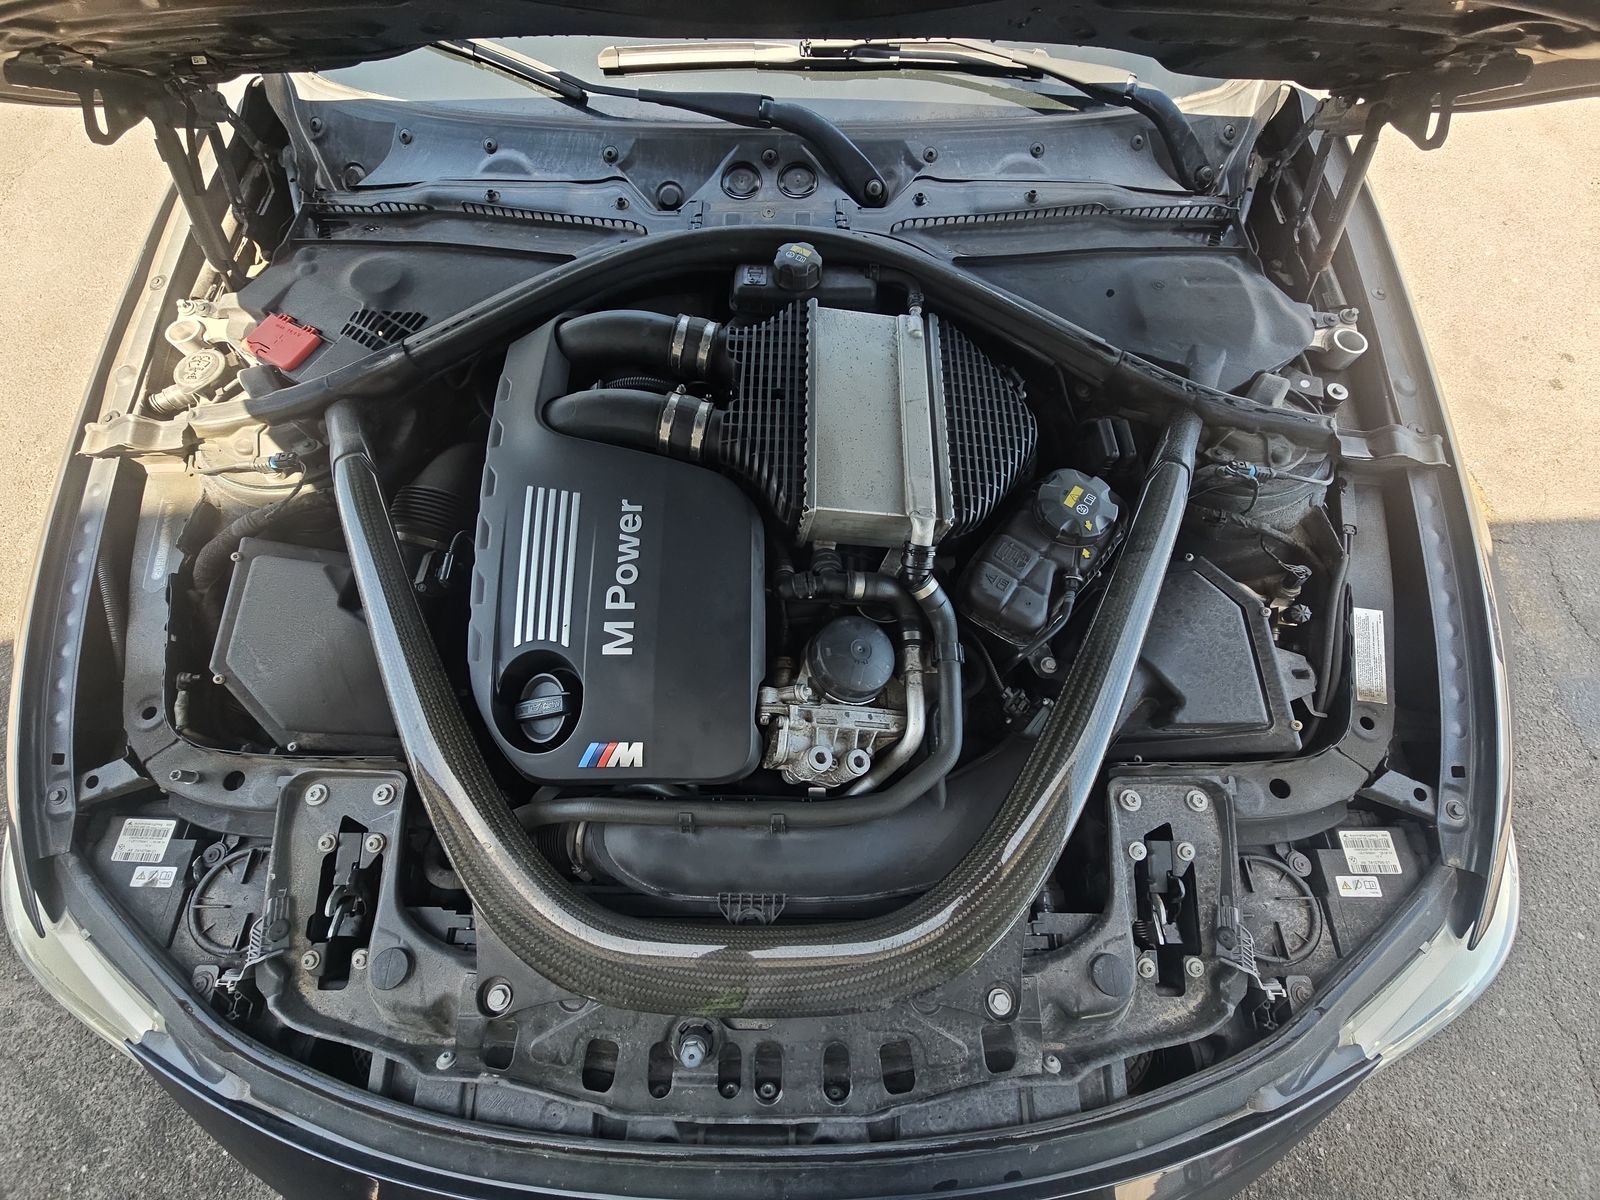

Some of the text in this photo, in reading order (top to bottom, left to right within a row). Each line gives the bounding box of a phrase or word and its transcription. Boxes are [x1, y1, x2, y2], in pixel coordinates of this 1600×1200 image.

[602, 499, 643, 655] M Power
[605, 742, 644, 768] M
